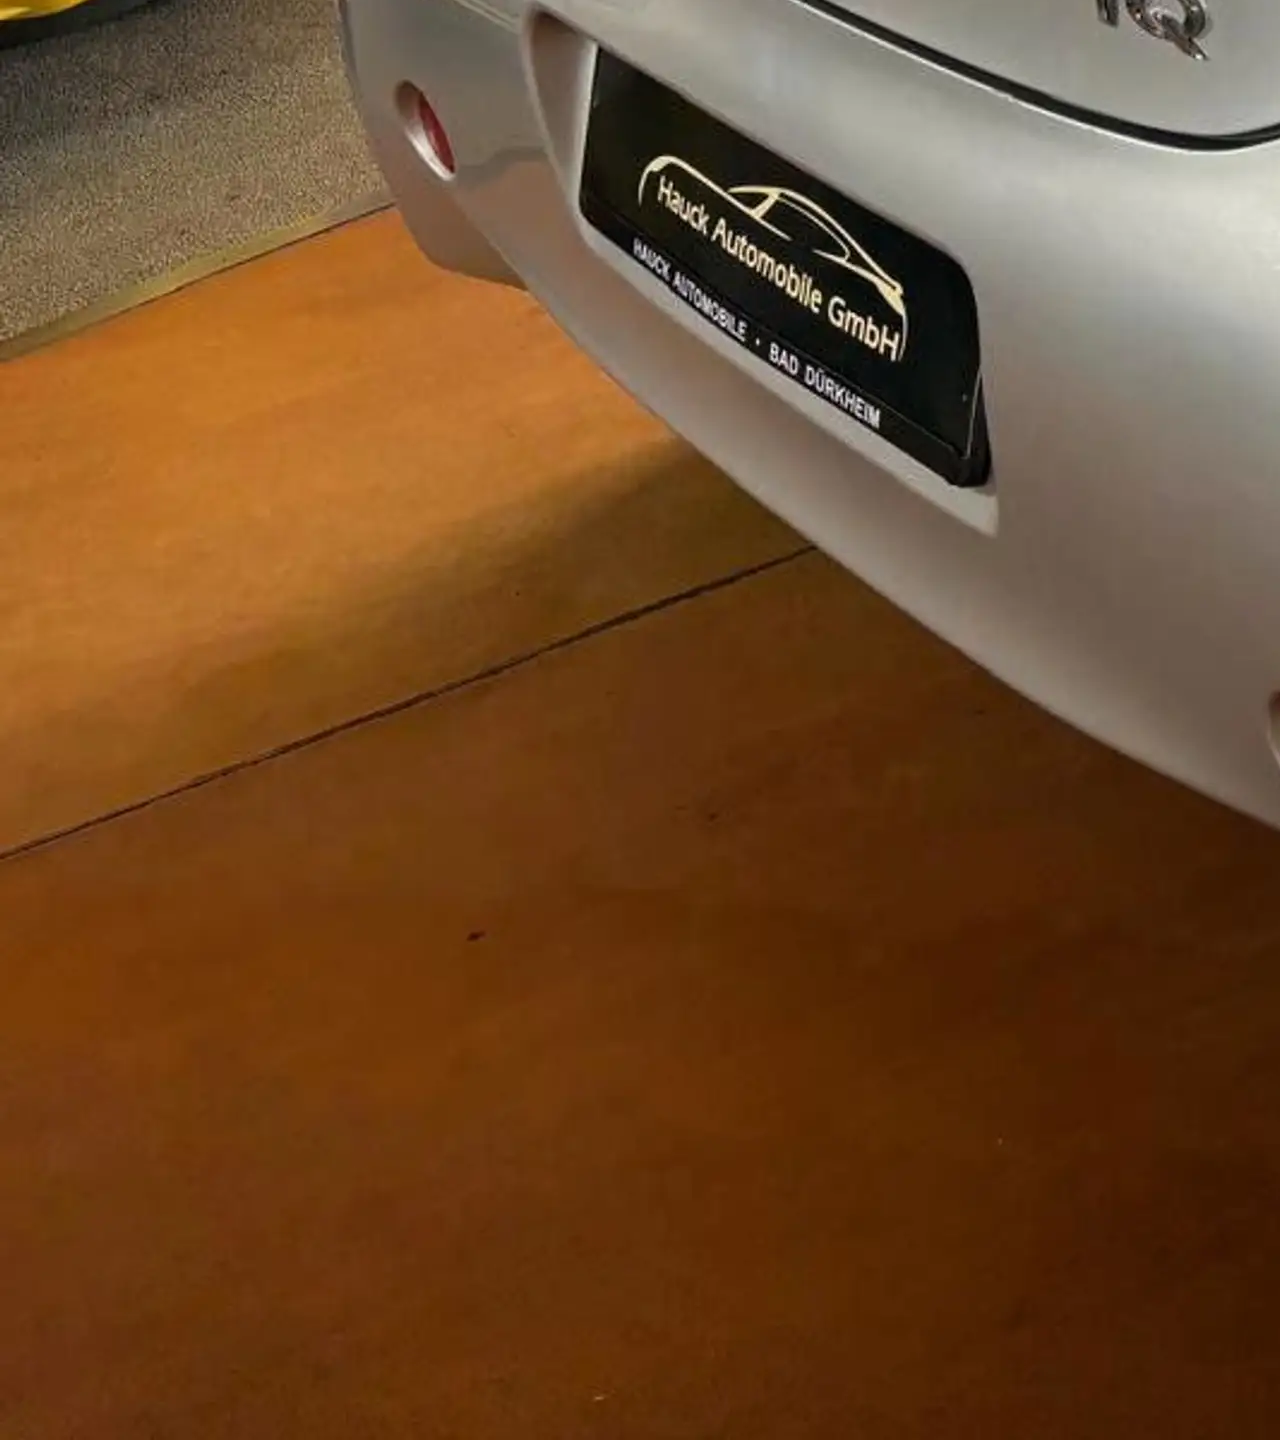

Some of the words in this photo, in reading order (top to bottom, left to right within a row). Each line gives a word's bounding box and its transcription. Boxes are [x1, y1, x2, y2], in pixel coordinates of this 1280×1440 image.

[633, 239, 671, 283] HAUCK
[673, 269, 748, 343] AUTOMOBILE
[769, 345, 799, 377] BAD
[804, 365, 881, 429] DÜRKHEIM
[657, 175, 709, 236] Hauck
[711, 216, 821, 315] Automobile
[829, 299, 900, 362] GmbH
